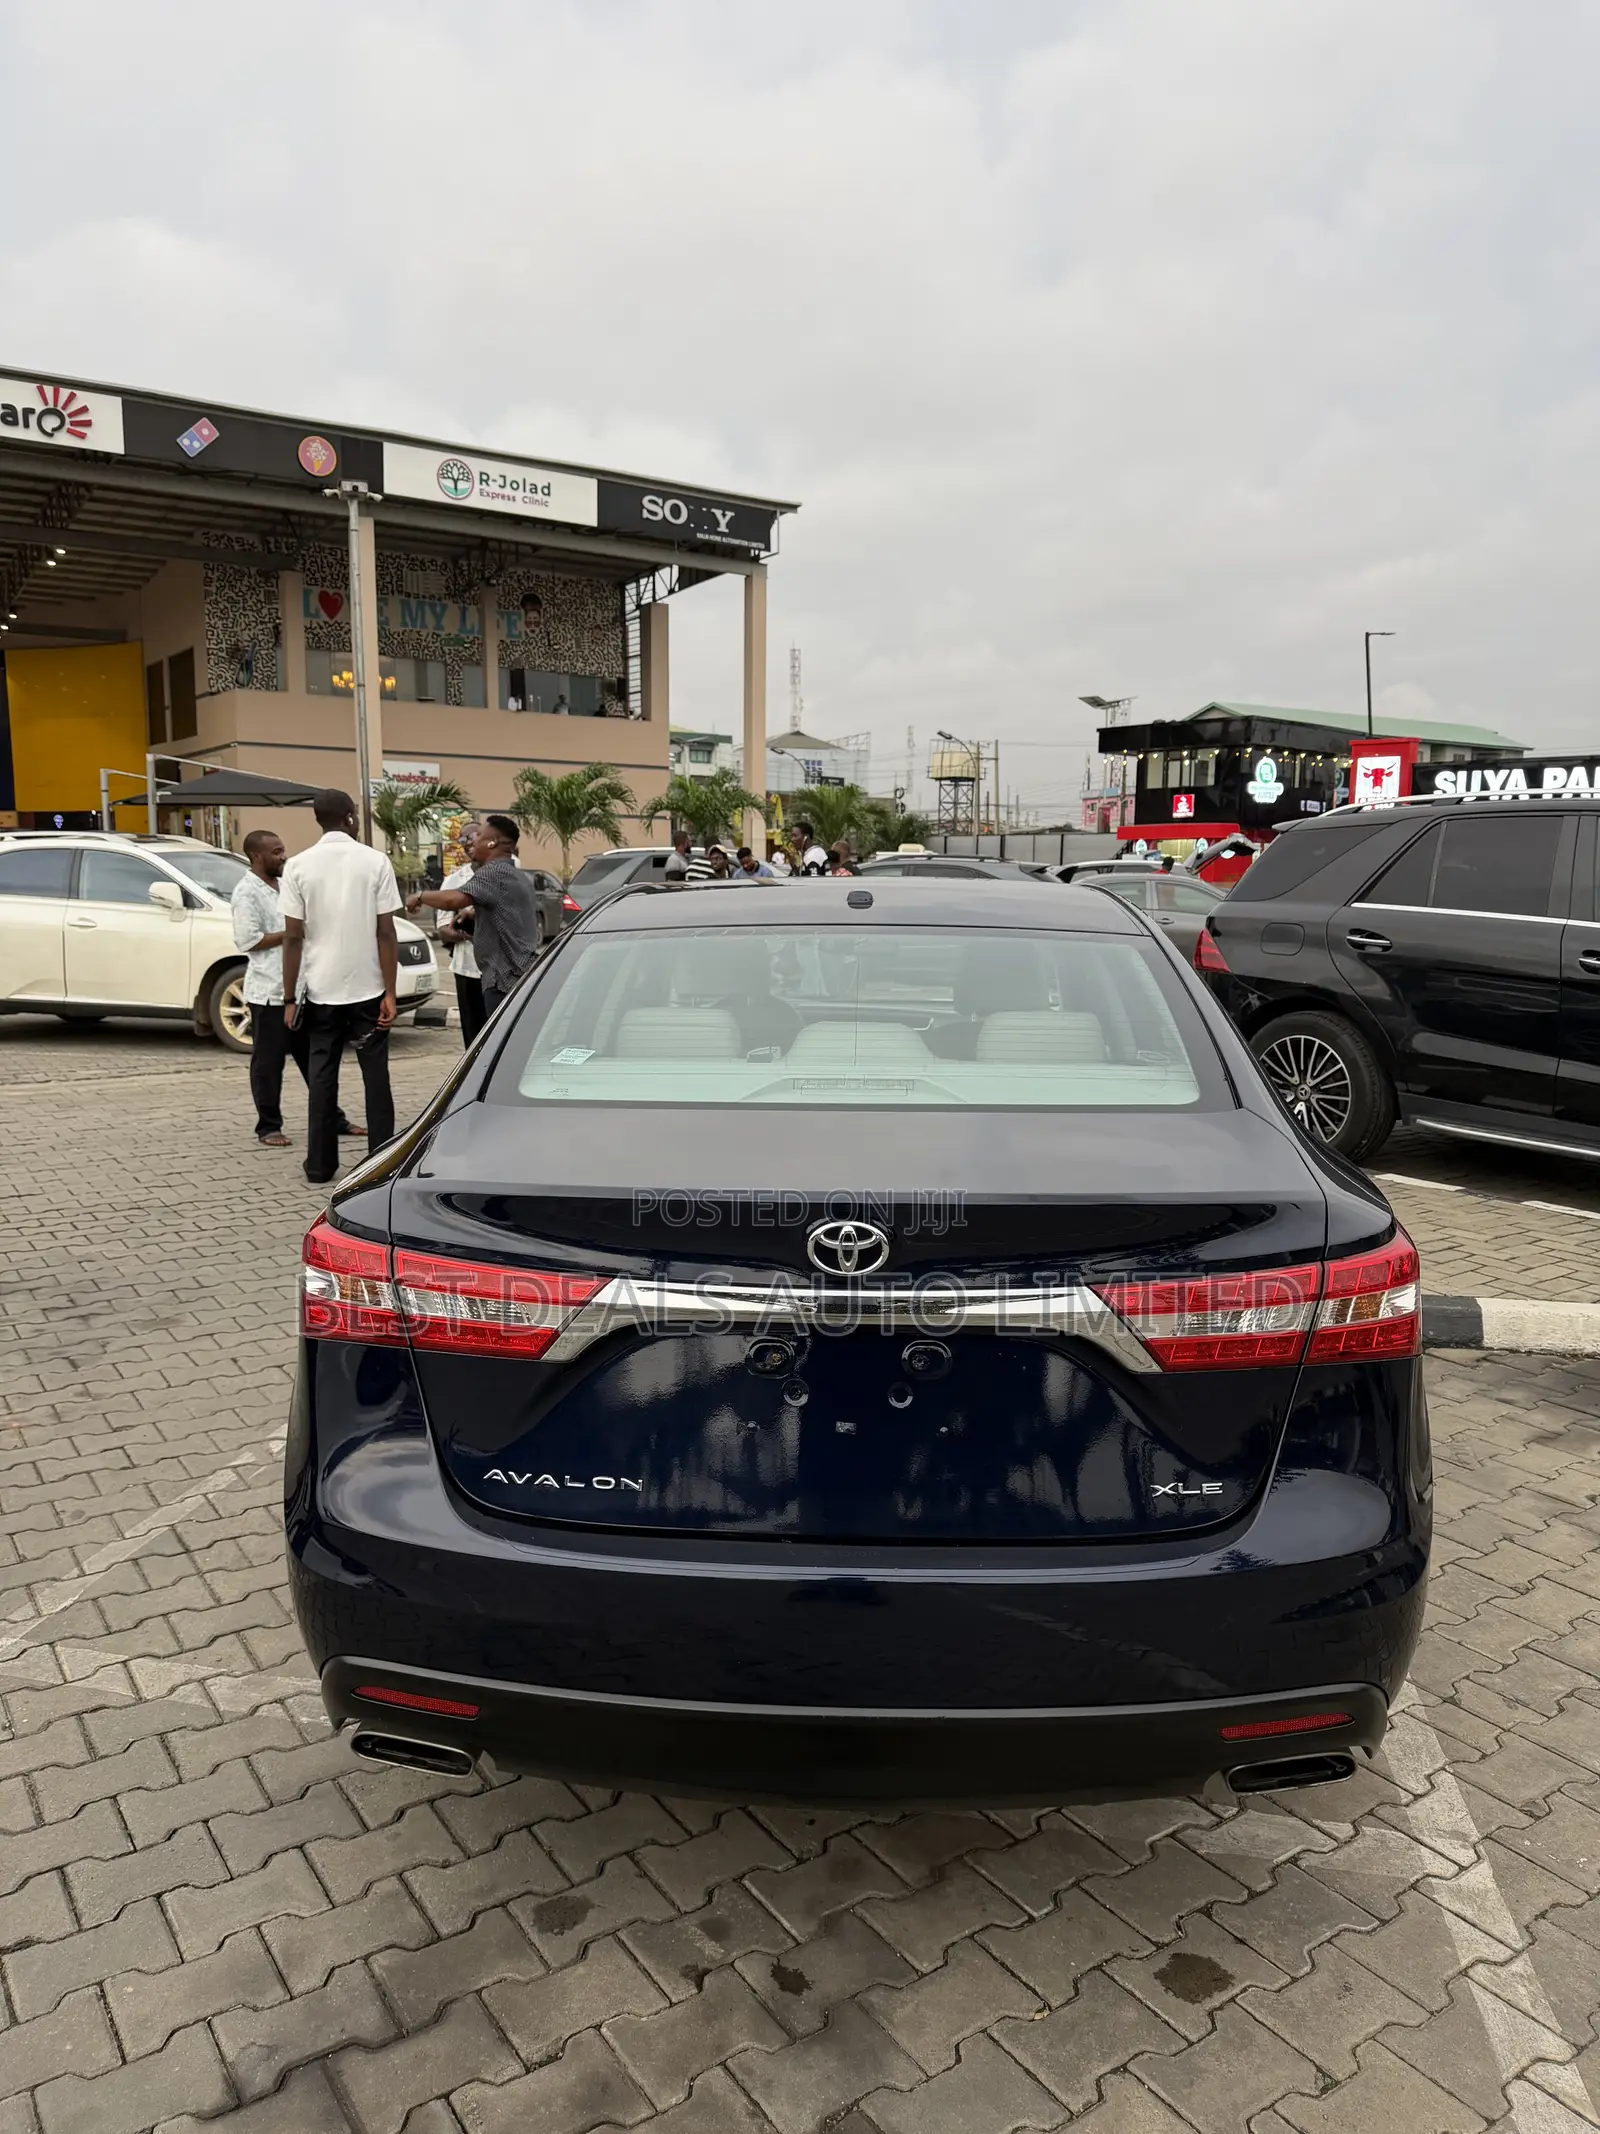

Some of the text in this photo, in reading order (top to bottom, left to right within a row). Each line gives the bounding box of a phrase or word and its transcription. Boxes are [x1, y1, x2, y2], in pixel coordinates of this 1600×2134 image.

[478, 470, 552, 497] R-Jolad
[479, 488, 550, 507] Express Clinic
[641, 495, 735, 533] SOY
[400, 600, 448, 632] MY
[1433, 765, 1600, 802] SUYA PA
[482, 1468, 644, 1492] AVALON
[1150, 1481, 1223, 1498] XLE
